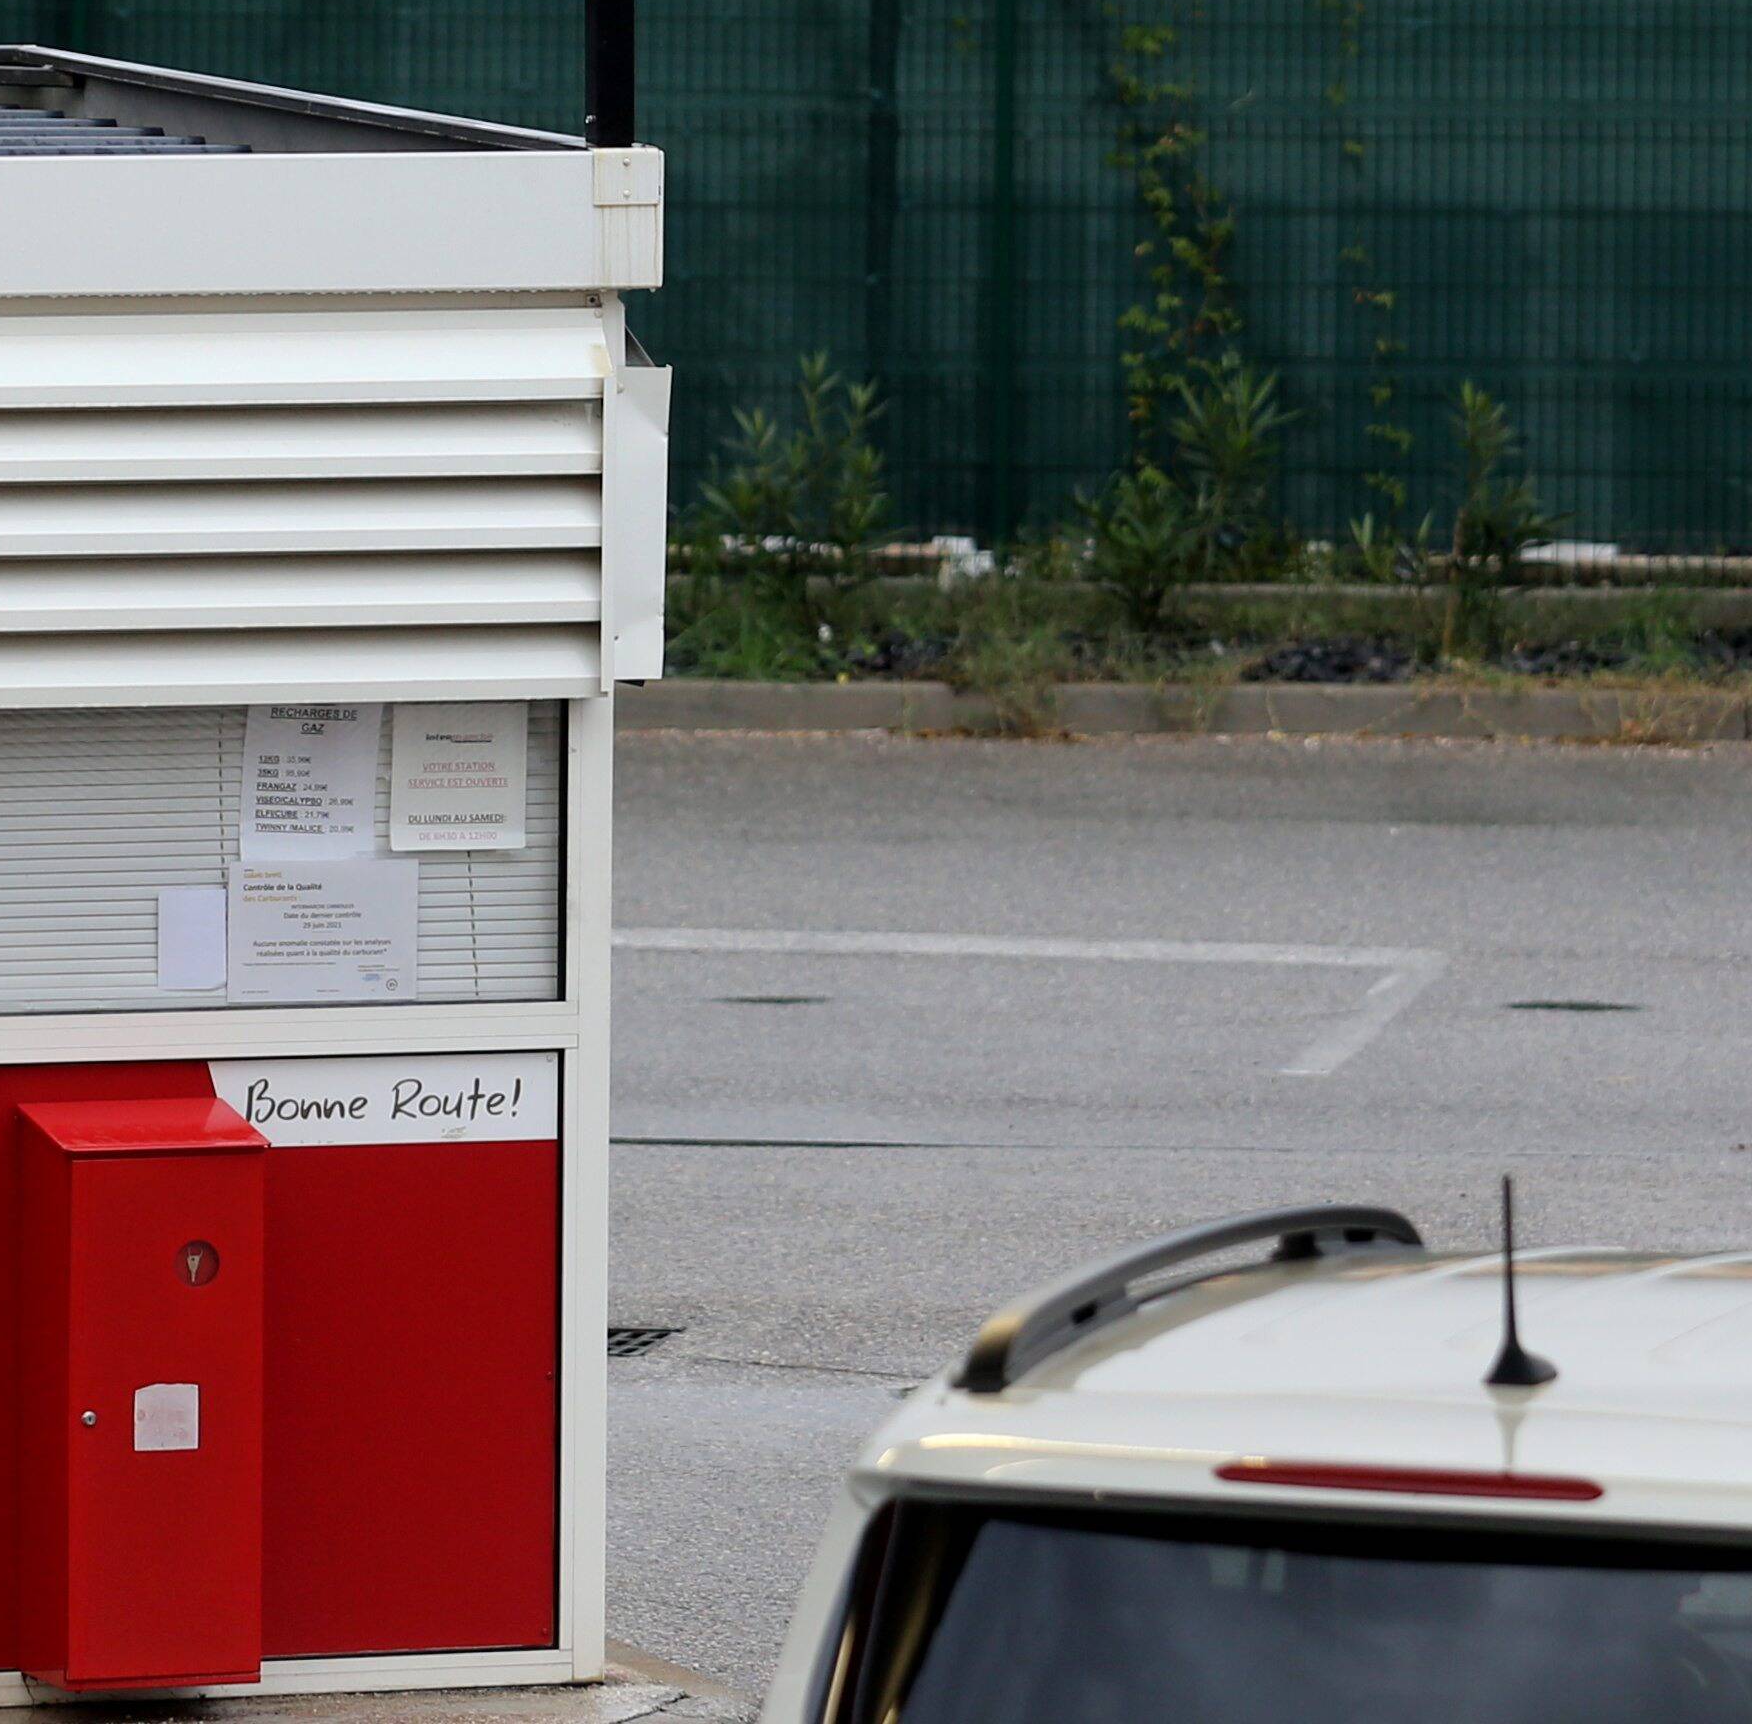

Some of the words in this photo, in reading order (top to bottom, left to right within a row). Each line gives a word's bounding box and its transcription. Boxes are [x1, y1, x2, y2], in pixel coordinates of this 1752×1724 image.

[271, 707, 339, 720] RECHARGES
[342, 710, 358, 721] DE
[301, 723, 325, 734] GAZ
[243, 883, 274, 891] Contrôle
[276, 883, 286, 891] de
[296, 883, 322, 892] Qualité
[245, 1078, 368, 1123] Bonne
[391, 1077, 521, 1122] Route!
